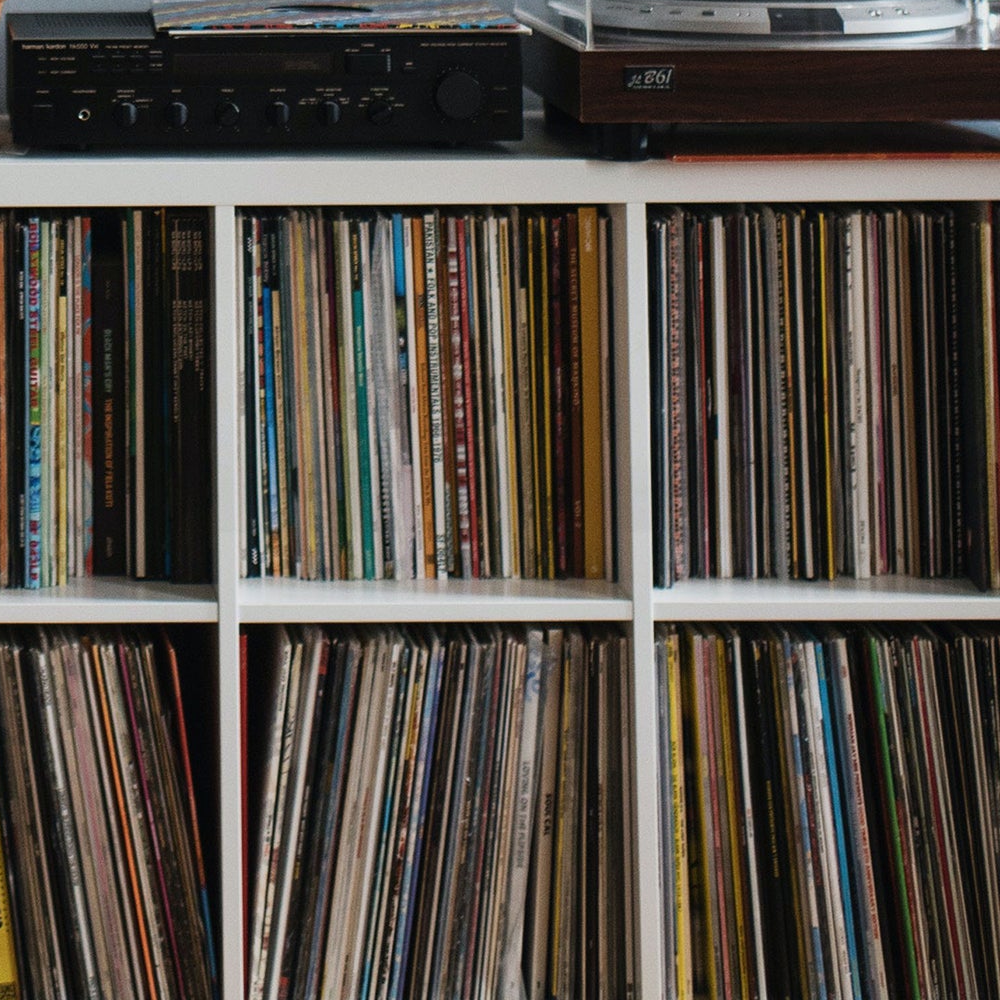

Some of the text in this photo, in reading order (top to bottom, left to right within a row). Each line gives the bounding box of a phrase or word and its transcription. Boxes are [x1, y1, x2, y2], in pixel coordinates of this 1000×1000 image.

[424, 222, 434, 263] PAKISTAN
[569, 248, 577, 266] THE
[426, 278, 435, 299] FOLK
[569, 269, 578, 301] SECRET
[29, 223, 39, 409] BOLLYWOOD STEEL GUITAR
[428, 302, 436, 320] AND
[428, 324, 437, 340] POP
[570, 305, 578, 344] MUSEUM
[430, 342, 441, 414] INSTRUMENTALS
[518, 798, 527, 811] ON
